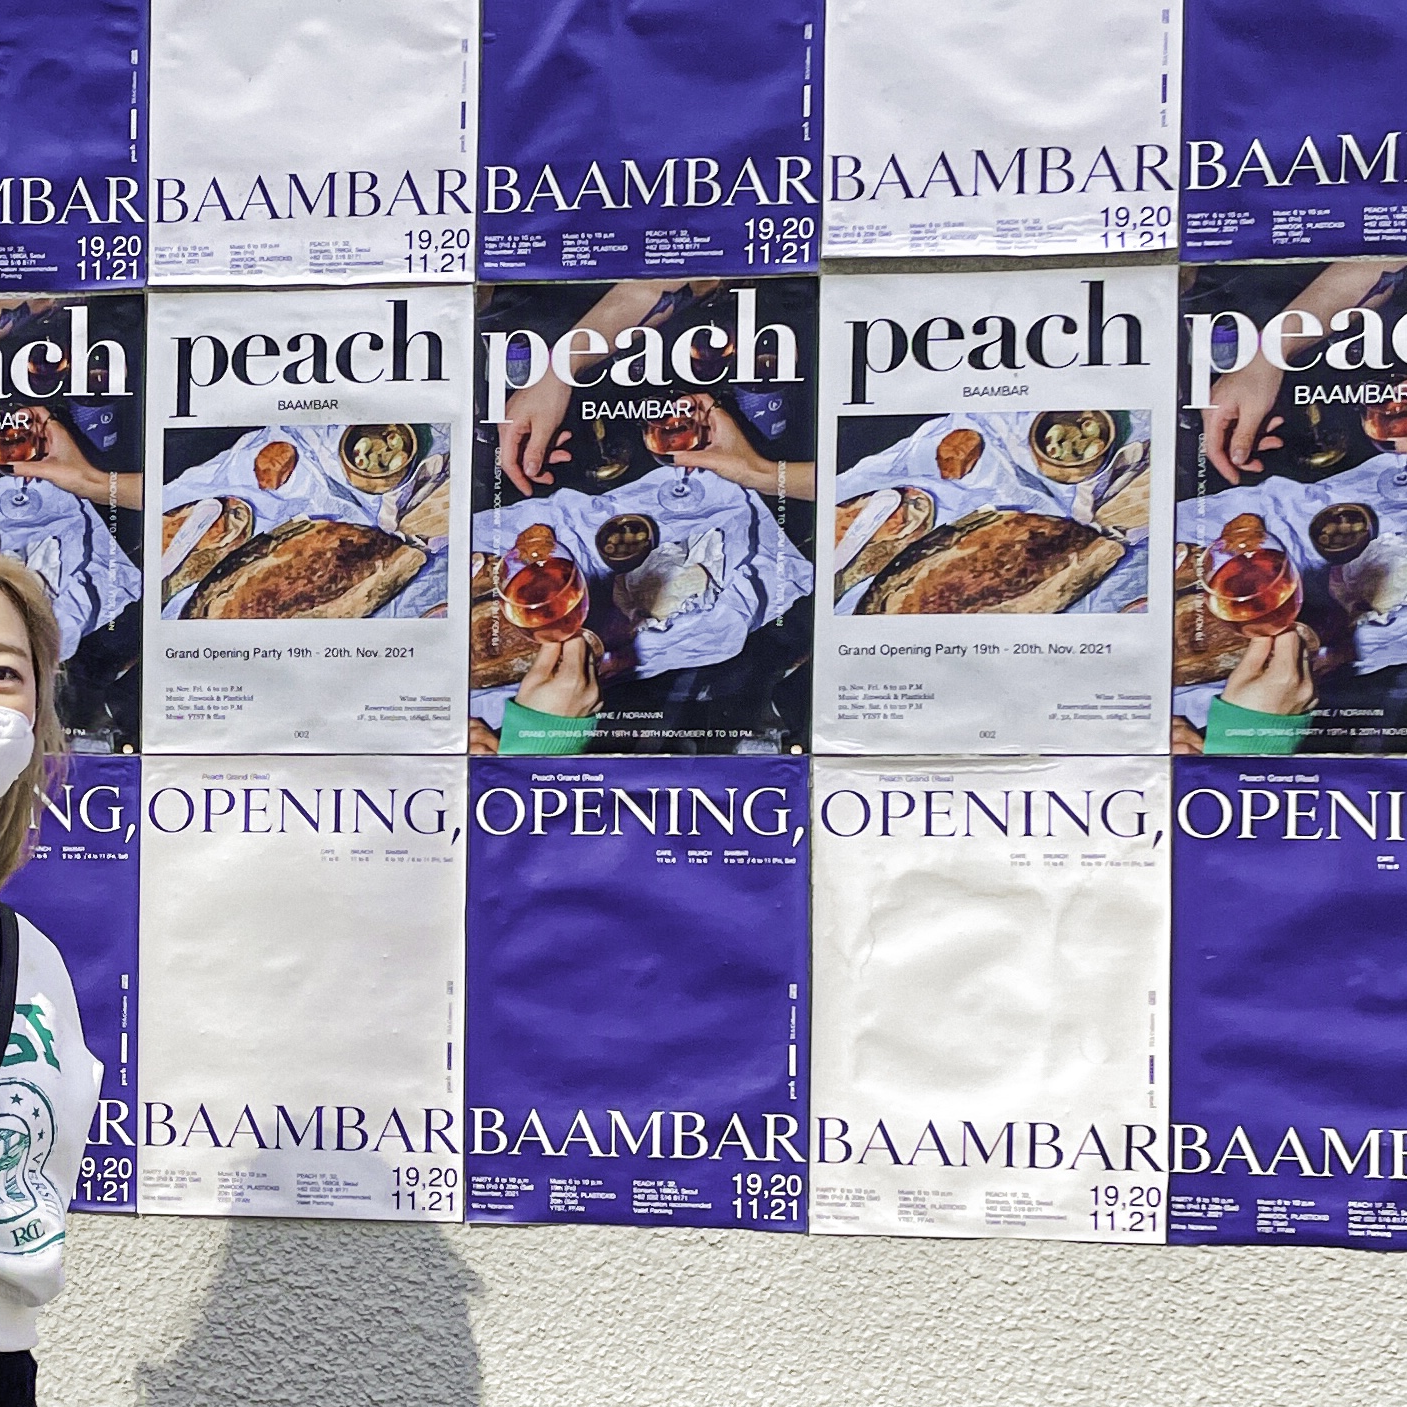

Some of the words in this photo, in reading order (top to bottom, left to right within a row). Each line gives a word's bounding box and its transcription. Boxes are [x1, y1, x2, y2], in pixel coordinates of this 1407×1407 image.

[828, 144, 1177, 201] BAAMBAR
[1185, 132, 1407, 190] BAAM
[153, 168, 474, 223] BAAMBAR
[482, 155, 820, 213] BAAMBAR
[744, 217, 815, 243] 19,20
[1100, 206, 1172, 231] 19,20
[77, 235, 142, 261] 19,20
[404, 228, 470, 253] 19,20
[743, 242, 810, 264] 11.21
[77, 259, 138, 281] 11.21
[404, 252, 467, 273] 11.21
[479, 287, 805, 423] peach
[842, 280, 1150, 405] peach
[169, 299, 450, 418] peach
[963, 385, 1030, 397] BAAMBAR
[277, 399, 339, 411] BAAMBAR
[581, 399, 692, 421] BAAMBAR
[165, 648, 200, 659] Grand
[203, 647, 250, 661] Opening
[253, 647, 282, 661] Party
[287, 647, 312, 659] 19th
[384, 647, 414, 658] 2021
[838, 644, 876, 656] Grand
[880, 643, 931, 657] Opening
[935, 643, 968, 657] Party
[973, 643, 1000, 655] 19th
[1079, 643, 1112, 655] 2021
[715, 730, 726, 738] TO
[148, 787, 461, 846] OPENING,
[475, 787, 805, 848] OPENING,
[821, 789, 1164, 850] OPENING,
[86, 1099, 136, 1147] R
[143, 1102, 461, 1154] BAAMBAR
[469, 1107, 807, 1162] BAAMBAR
[815, 1117, 1166, 1172] BAAMBAR
[392, 1166, 458, 1190] 19,20
[732, 1173, 803, 1199] 19,20
[391, 1190, 454, 1211] 11.21
[732, 1197, 798, 1221] 11.21
[1090, 1185, 1161, 1210] 19,20
[1090, 1210, 1157, 1232] 11.21
